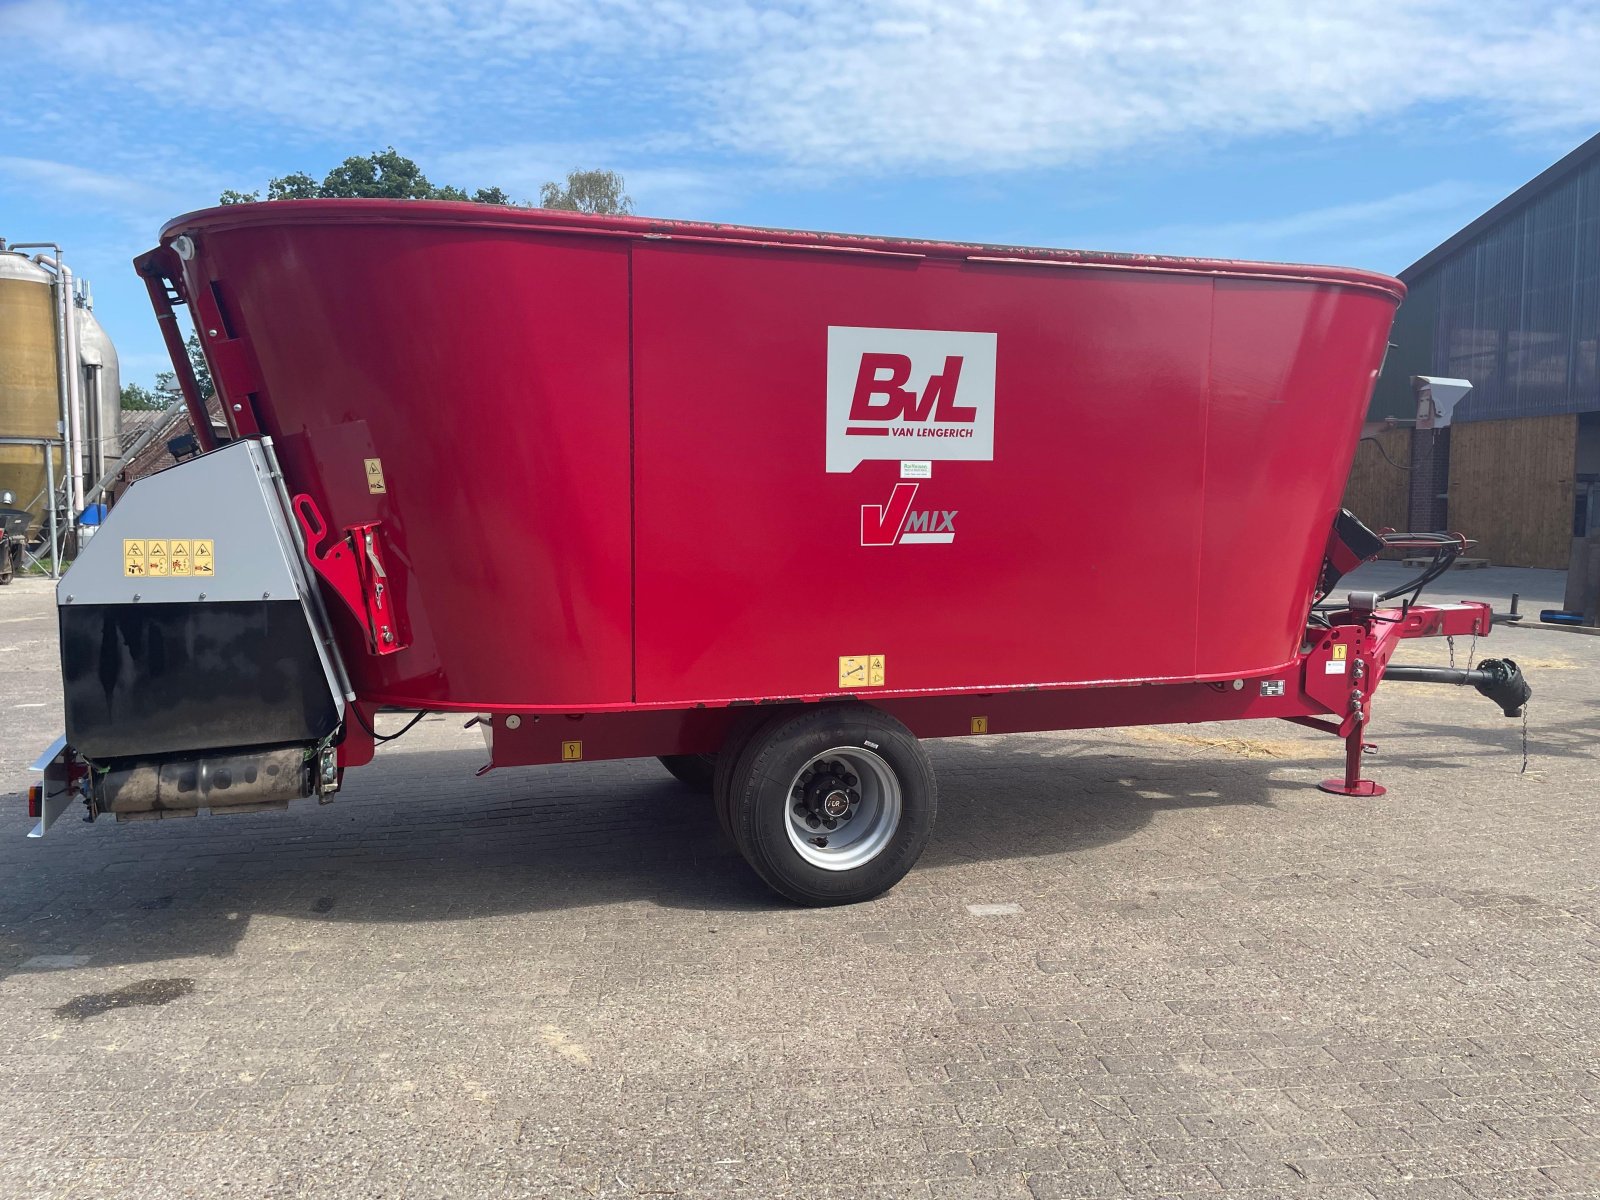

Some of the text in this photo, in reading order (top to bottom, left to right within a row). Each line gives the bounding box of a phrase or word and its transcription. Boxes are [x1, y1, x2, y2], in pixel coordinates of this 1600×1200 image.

[849, 353, 977, 422] BvL
[892, 427, 974, 438] VAN LENGERICH
[904, 511, 958, 531] MIX
